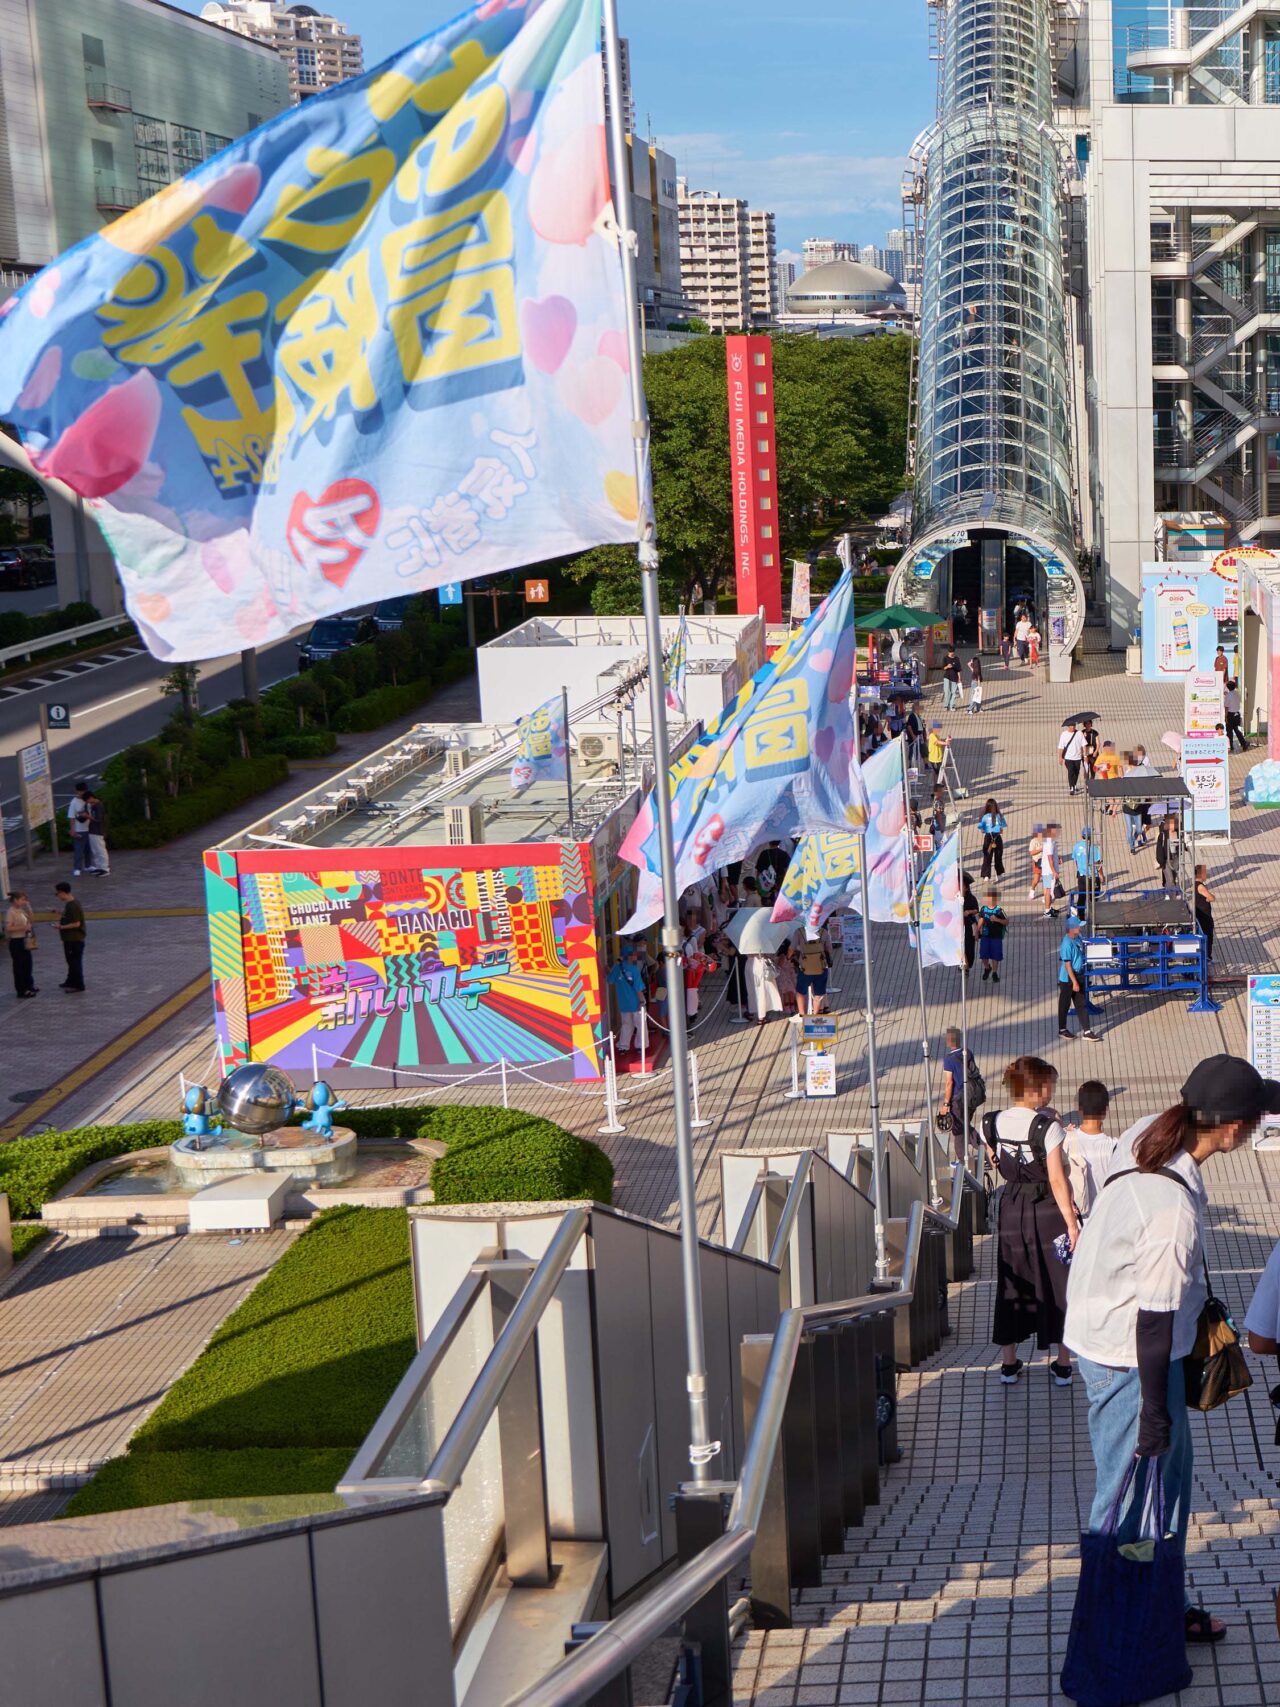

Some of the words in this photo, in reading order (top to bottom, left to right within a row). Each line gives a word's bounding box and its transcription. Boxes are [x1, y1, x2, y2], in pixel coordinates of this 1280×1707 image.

[733, 381, 744, 412] FUJI
[734, 418, 746, 466] MEDIA
[737, 471, 751, 548] HOLDINGS,
[740, 551, 752, 579] INC.
[1195, 774, 1217, 783] まるごと
[289, 897, 352, 917] CHOCOLATE
[291, 912, 332, 927] PLANET
[491, 870, 513, 938] SHIMOFURI
[309, 948, 512, 1032] 新しいカギ
